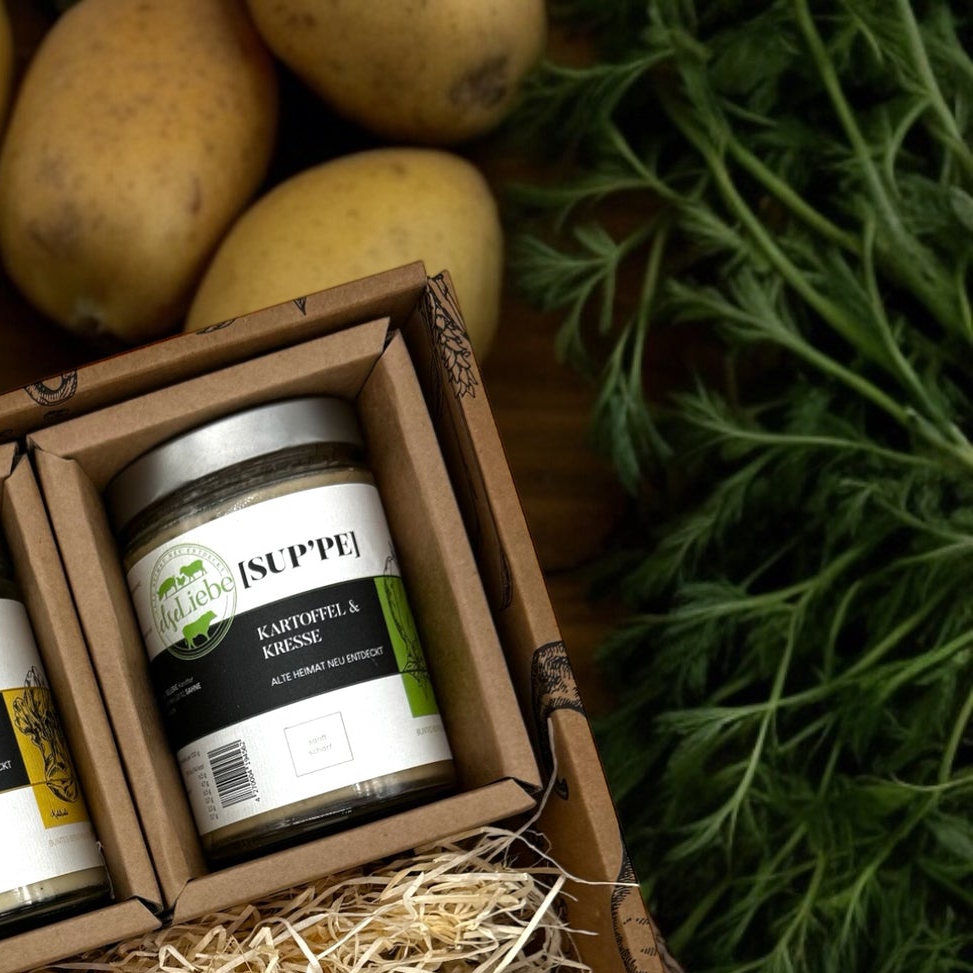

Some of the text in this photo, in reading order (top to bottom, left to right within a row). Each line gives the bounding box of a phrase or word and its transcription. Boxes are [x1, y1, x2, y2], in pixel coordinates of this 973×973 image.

[257, 599, 361, 641] KARTOFFEL &
[262, 629, 322, 660] KRESSE
[271, 646, 384, 687] ALTE HEIMAT NEU ENTDECKT
